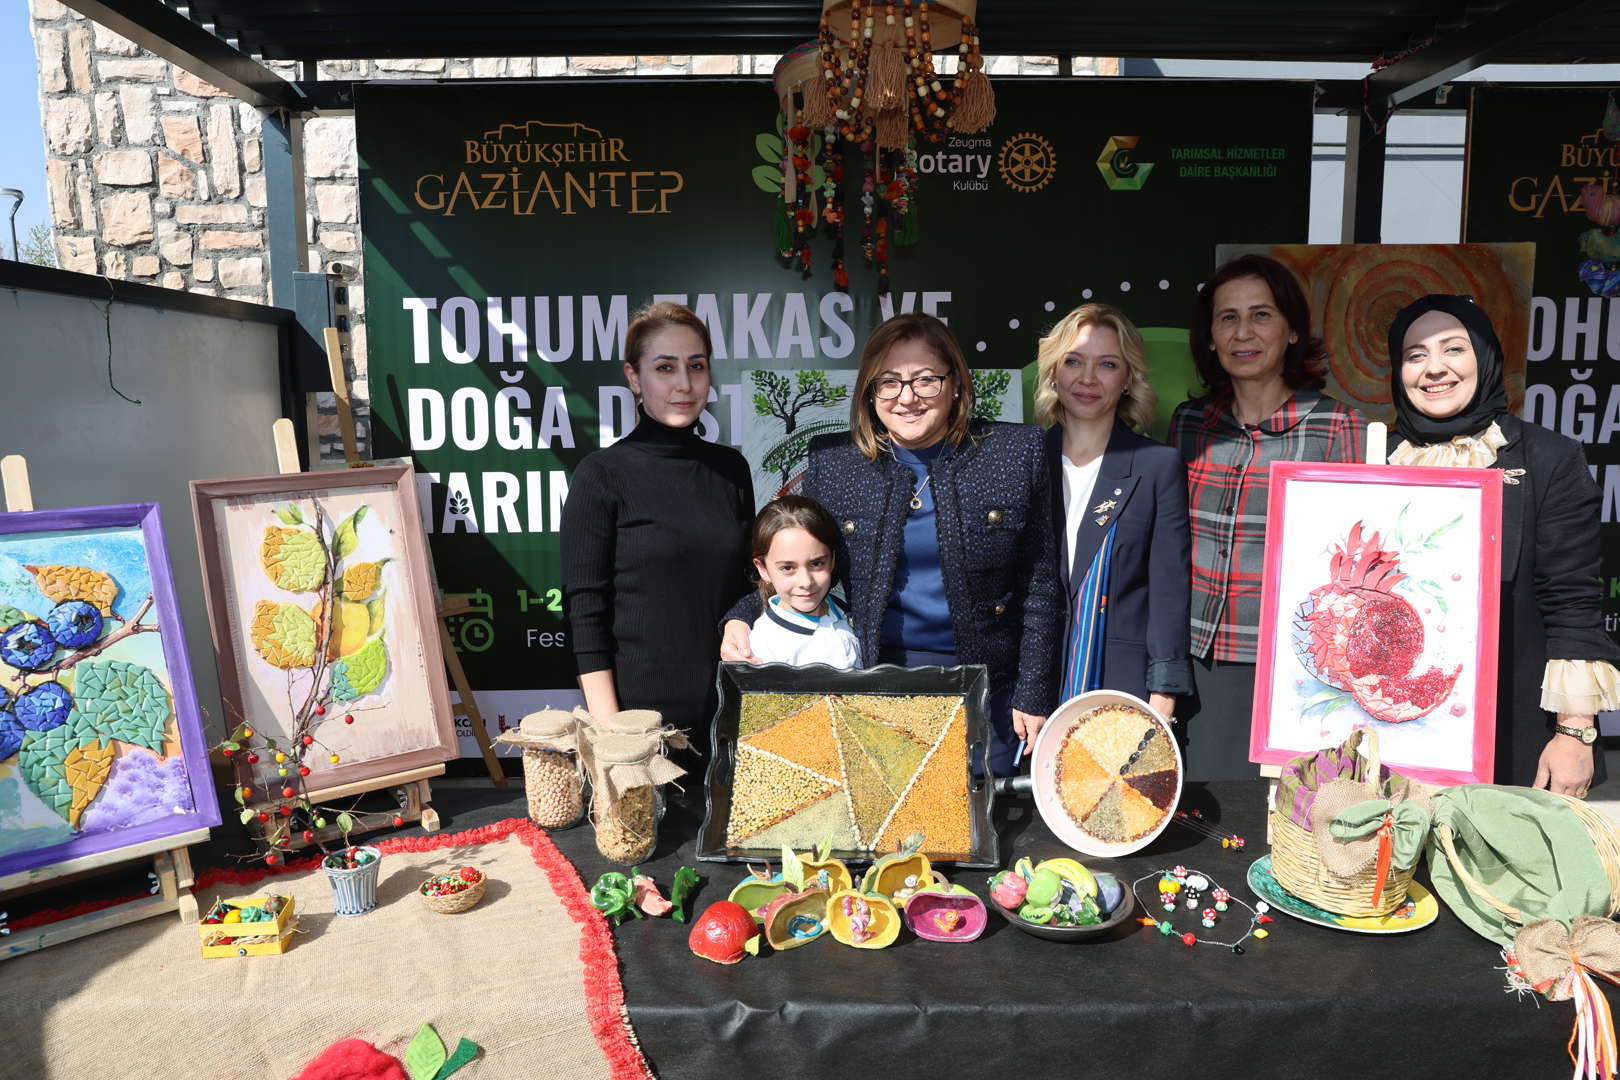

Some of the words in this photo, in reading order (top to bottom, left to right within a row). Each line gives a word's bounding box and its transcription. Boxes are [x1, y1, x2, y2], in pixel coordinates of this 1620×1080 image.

[464, 138, 631, 167] BÜYÜKŞEHİR
[948, 137, 992, 149] Zeugma
[1170, 147, 1224, 160] TARIMSAL
[1227, 145, 1286, 160] HİZMETLER
[1179, 163, 1211, 177] DAİRE
[1213, 163, 1277, 180] BAŞKANLIĞI
[413, 166, 685, 216] GAZİANTEP
[953, 180, 989, 191] Kulübü
[402, 294, 628, 365] TOHUM
[407, 370, 576, 452] DOĞA
